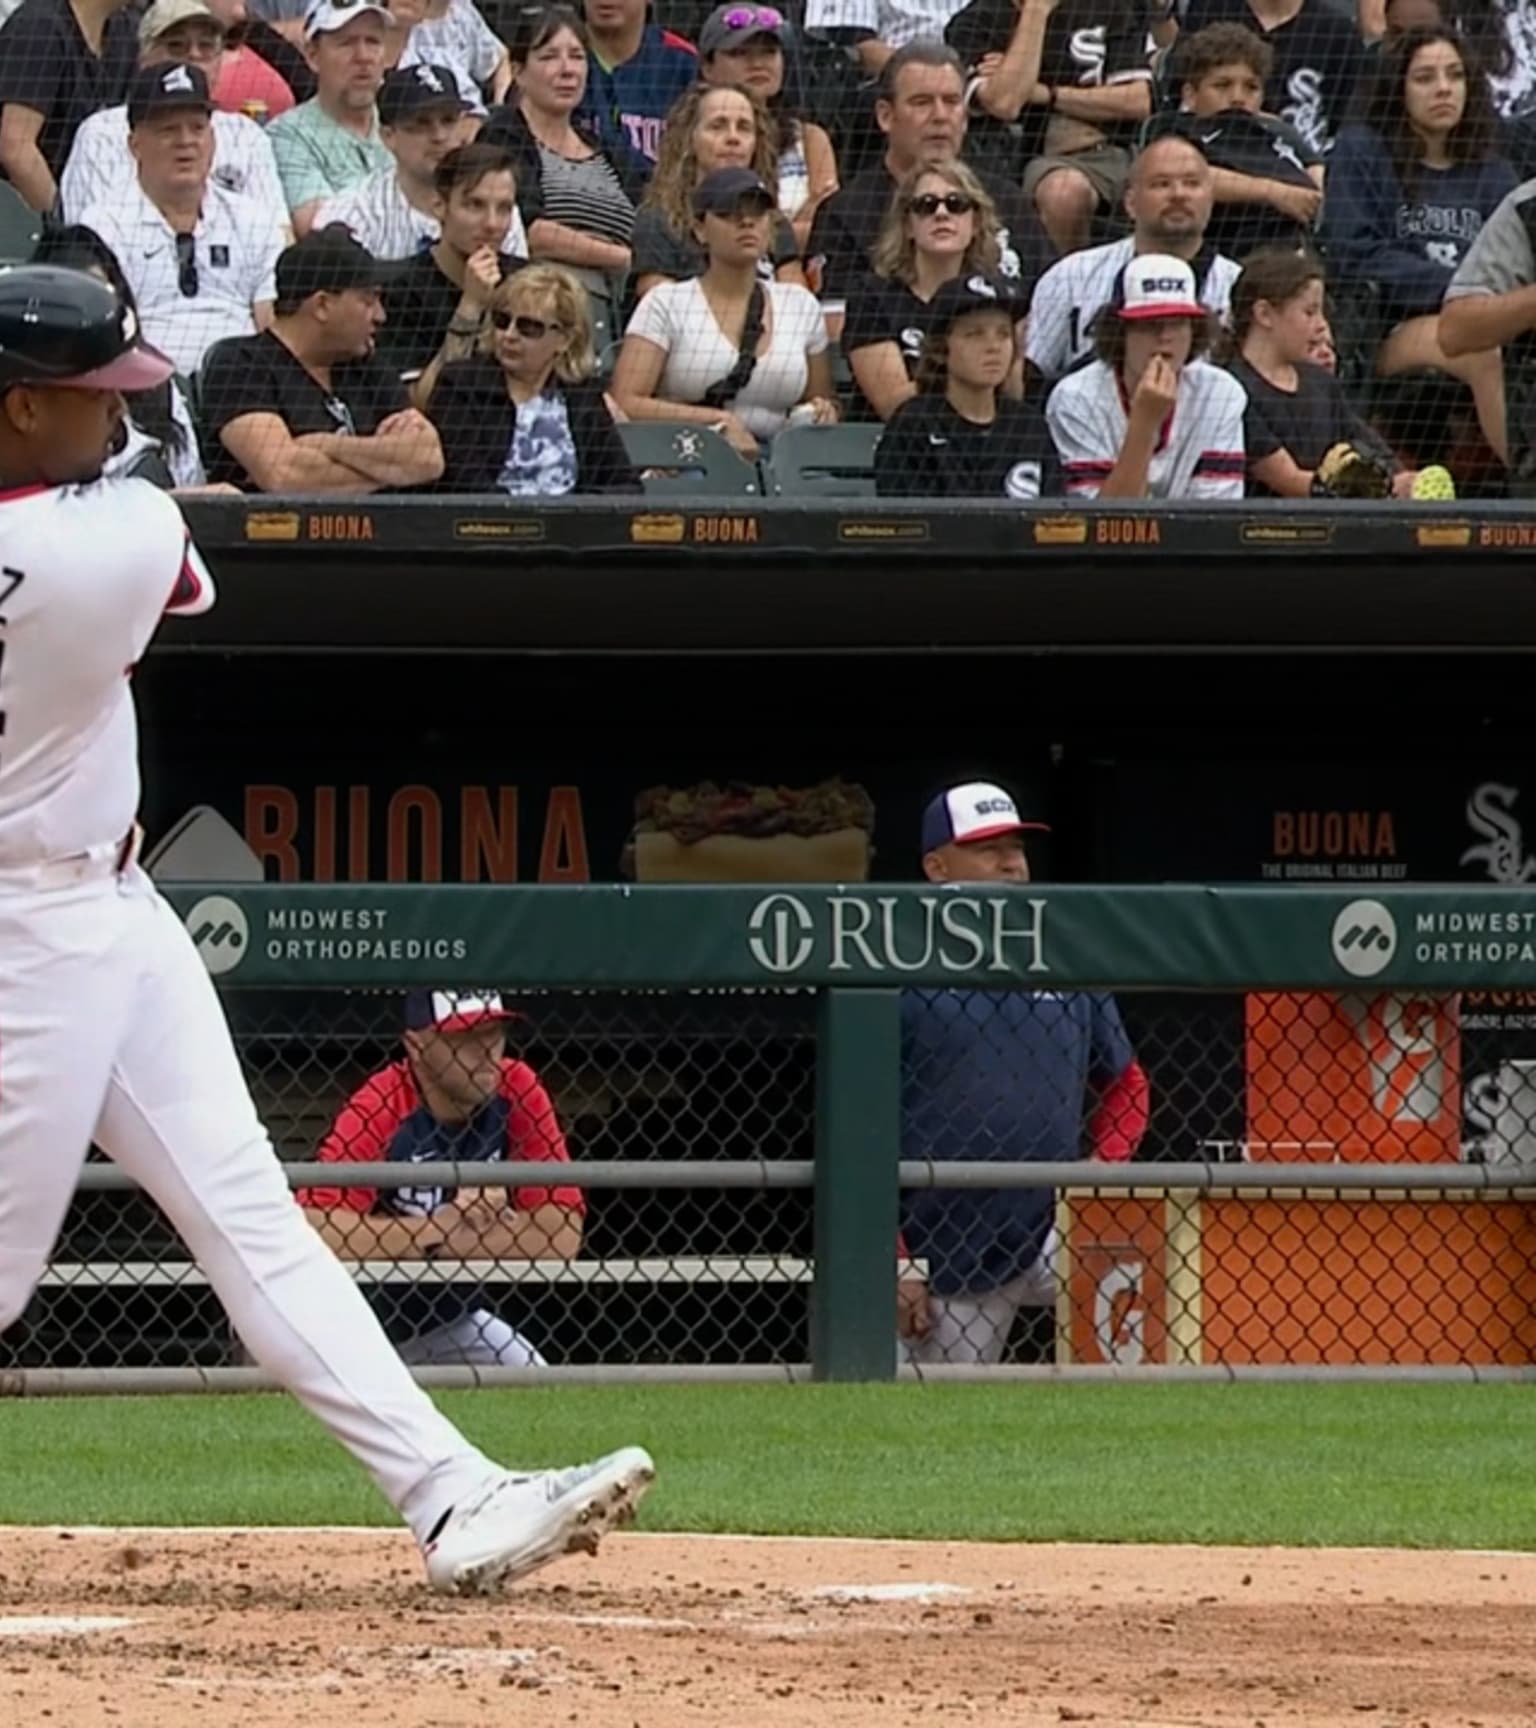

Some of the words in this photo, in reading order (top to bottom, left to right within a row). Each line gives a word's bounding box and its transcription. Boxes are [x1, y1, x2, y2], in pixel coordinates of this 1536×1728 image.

[1141, 277, 1187, 294] SOX
[308, 514, 374, 541] BUONA
[459, 522, 541, 537] whitesox.com
[693, 517, 758, 542] BUONA
[1096, 519, 1161, 544] BUONA
[243, 785, 593, 882] BUONA
[1273, 811, 1396, 857] BUONA
[1261, 863, 1282, 879] THE
[1285, 863, 1334, 879] ORIGINAL
[1336, 863, 1378, 879] ITALIAN
[1381, 863, 1408, 879] BEEF
[267, 908, 388, 931] MIDWEST
[1416, 912, 1536, 933] MIDWEST
[827, 897, 1049, 972] RUSH
[267, 938, 468, 960] ORTHOPAEDICS
[1416, 942, 1536, 963] ORTHOPA
